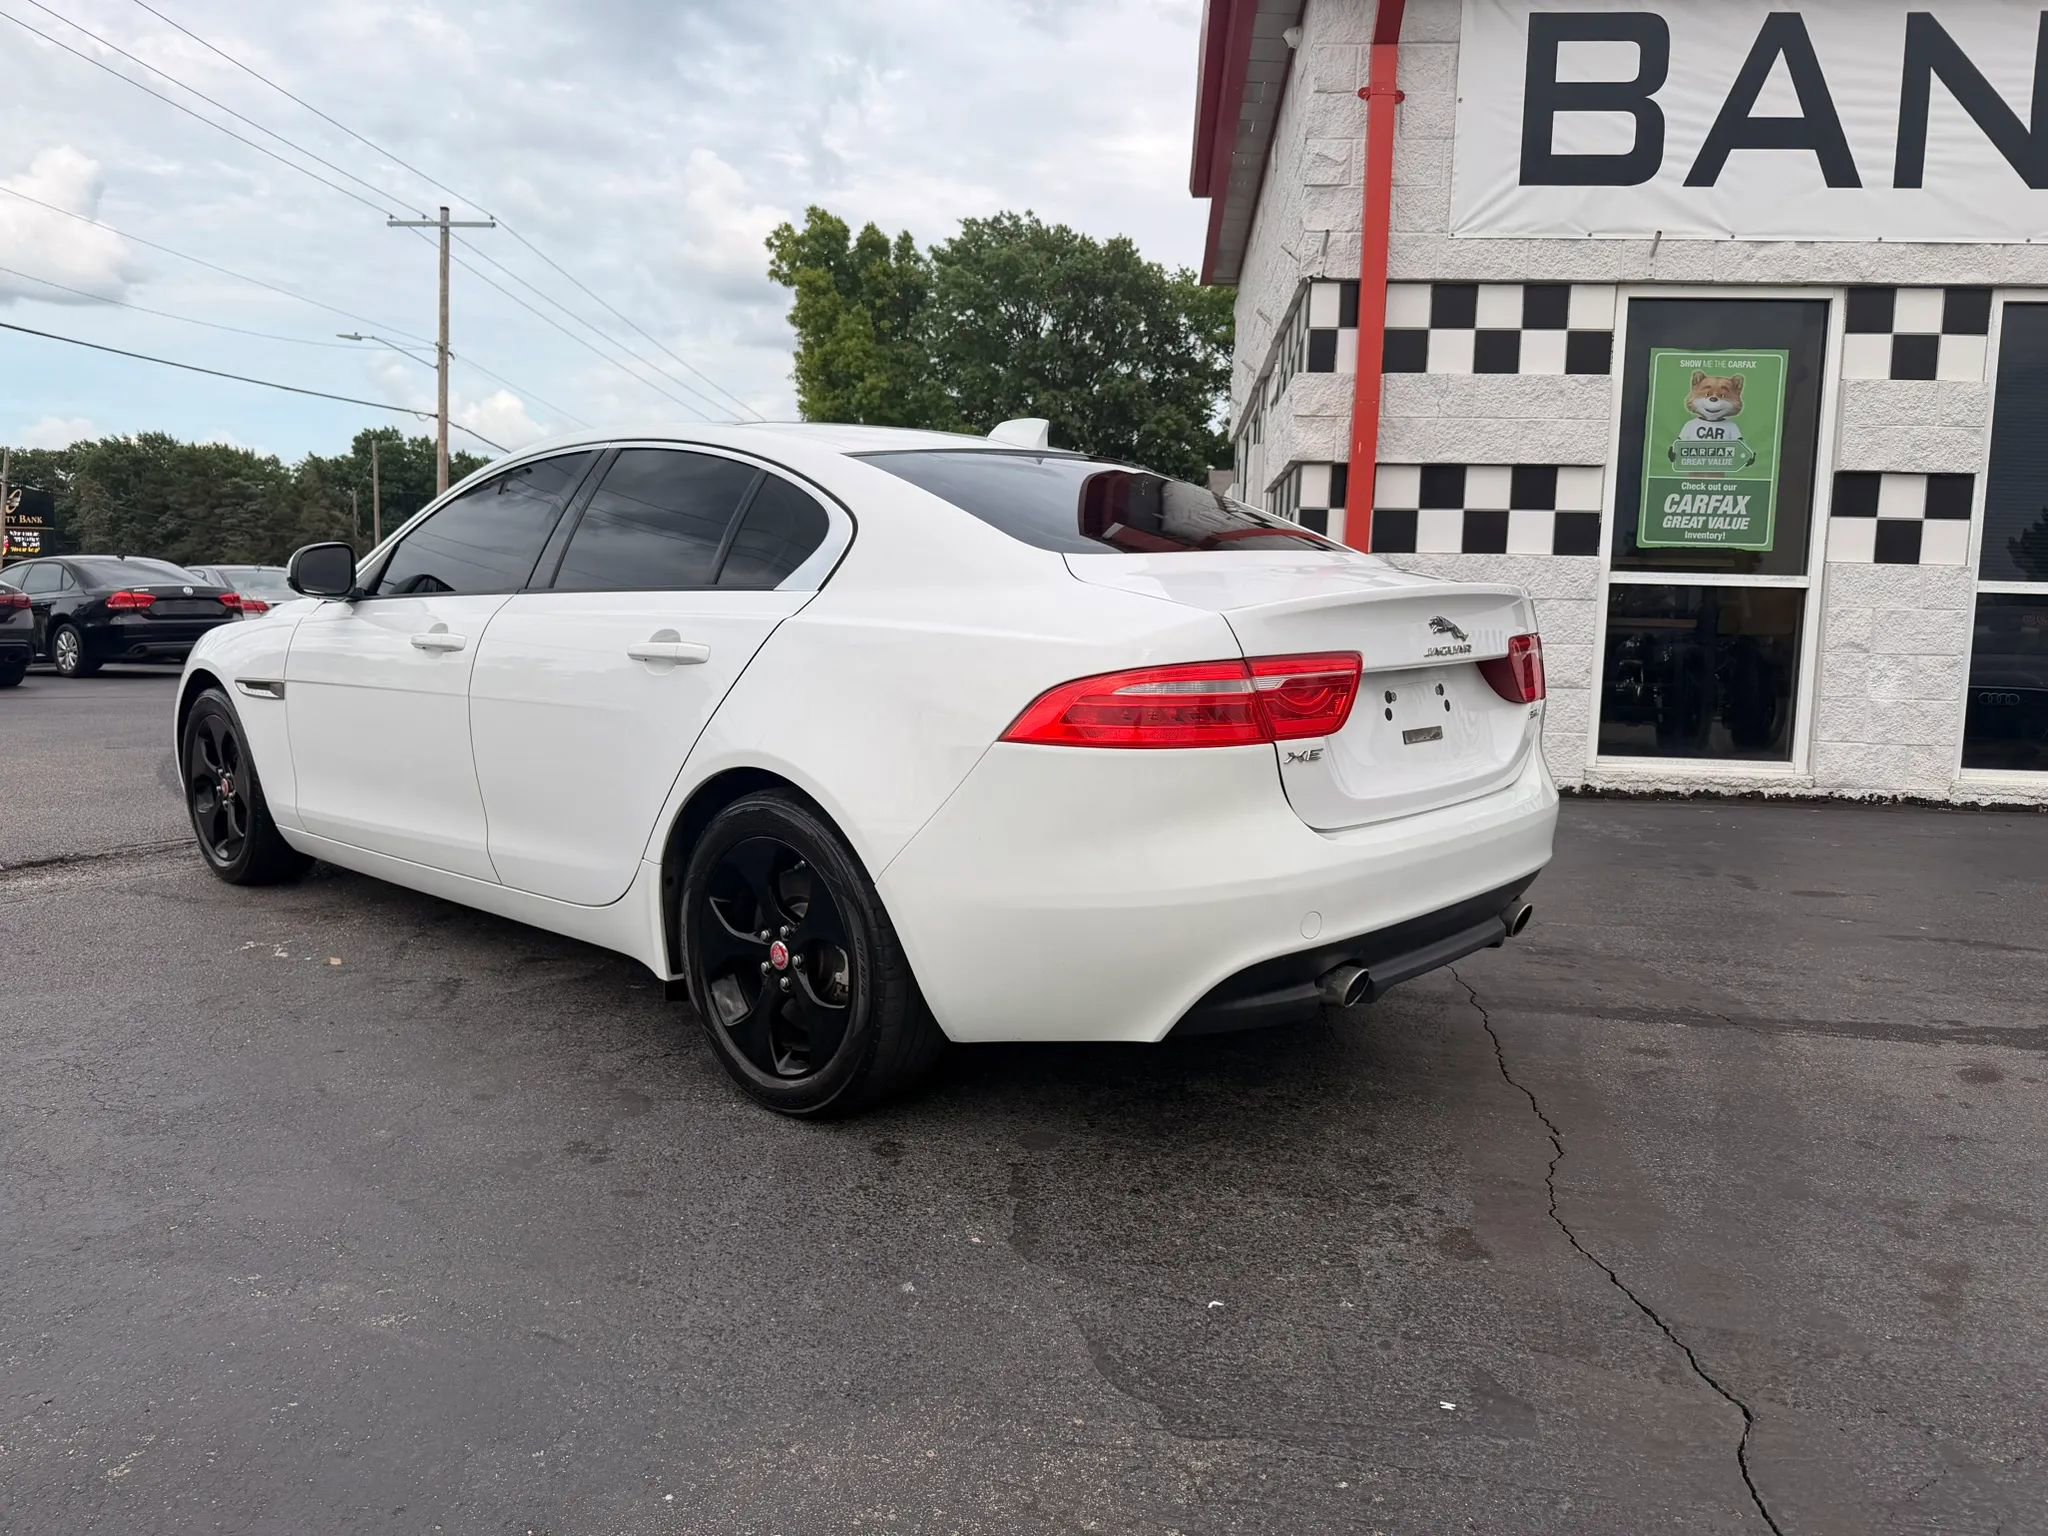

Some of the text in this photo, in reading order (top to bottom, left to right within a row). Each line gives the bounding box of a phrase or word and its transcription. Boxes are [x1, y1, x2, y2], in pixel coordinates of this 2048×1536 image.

[1519, 11, 2048, 189] BAN
[1680, 360, 1702, 368] SHOW
[1728, 360, 1757, 369] CARFAX
[1696, 426, 1725, 439] CAR
[1681, 447, 1735, 457] CARFAX
[1681, 482, 1706, 490] Check
[1708, 483, 1721, 491] out
[1663, 493, 1751, 515] CARFAX
[1662, 515, 1751, 530] GREAT VALUE
[1685, 531, 1726, 541] Inventory!
[1423, 644, 1472, 658] JAGUAR
[1283, 747, 1324, 764] XE
